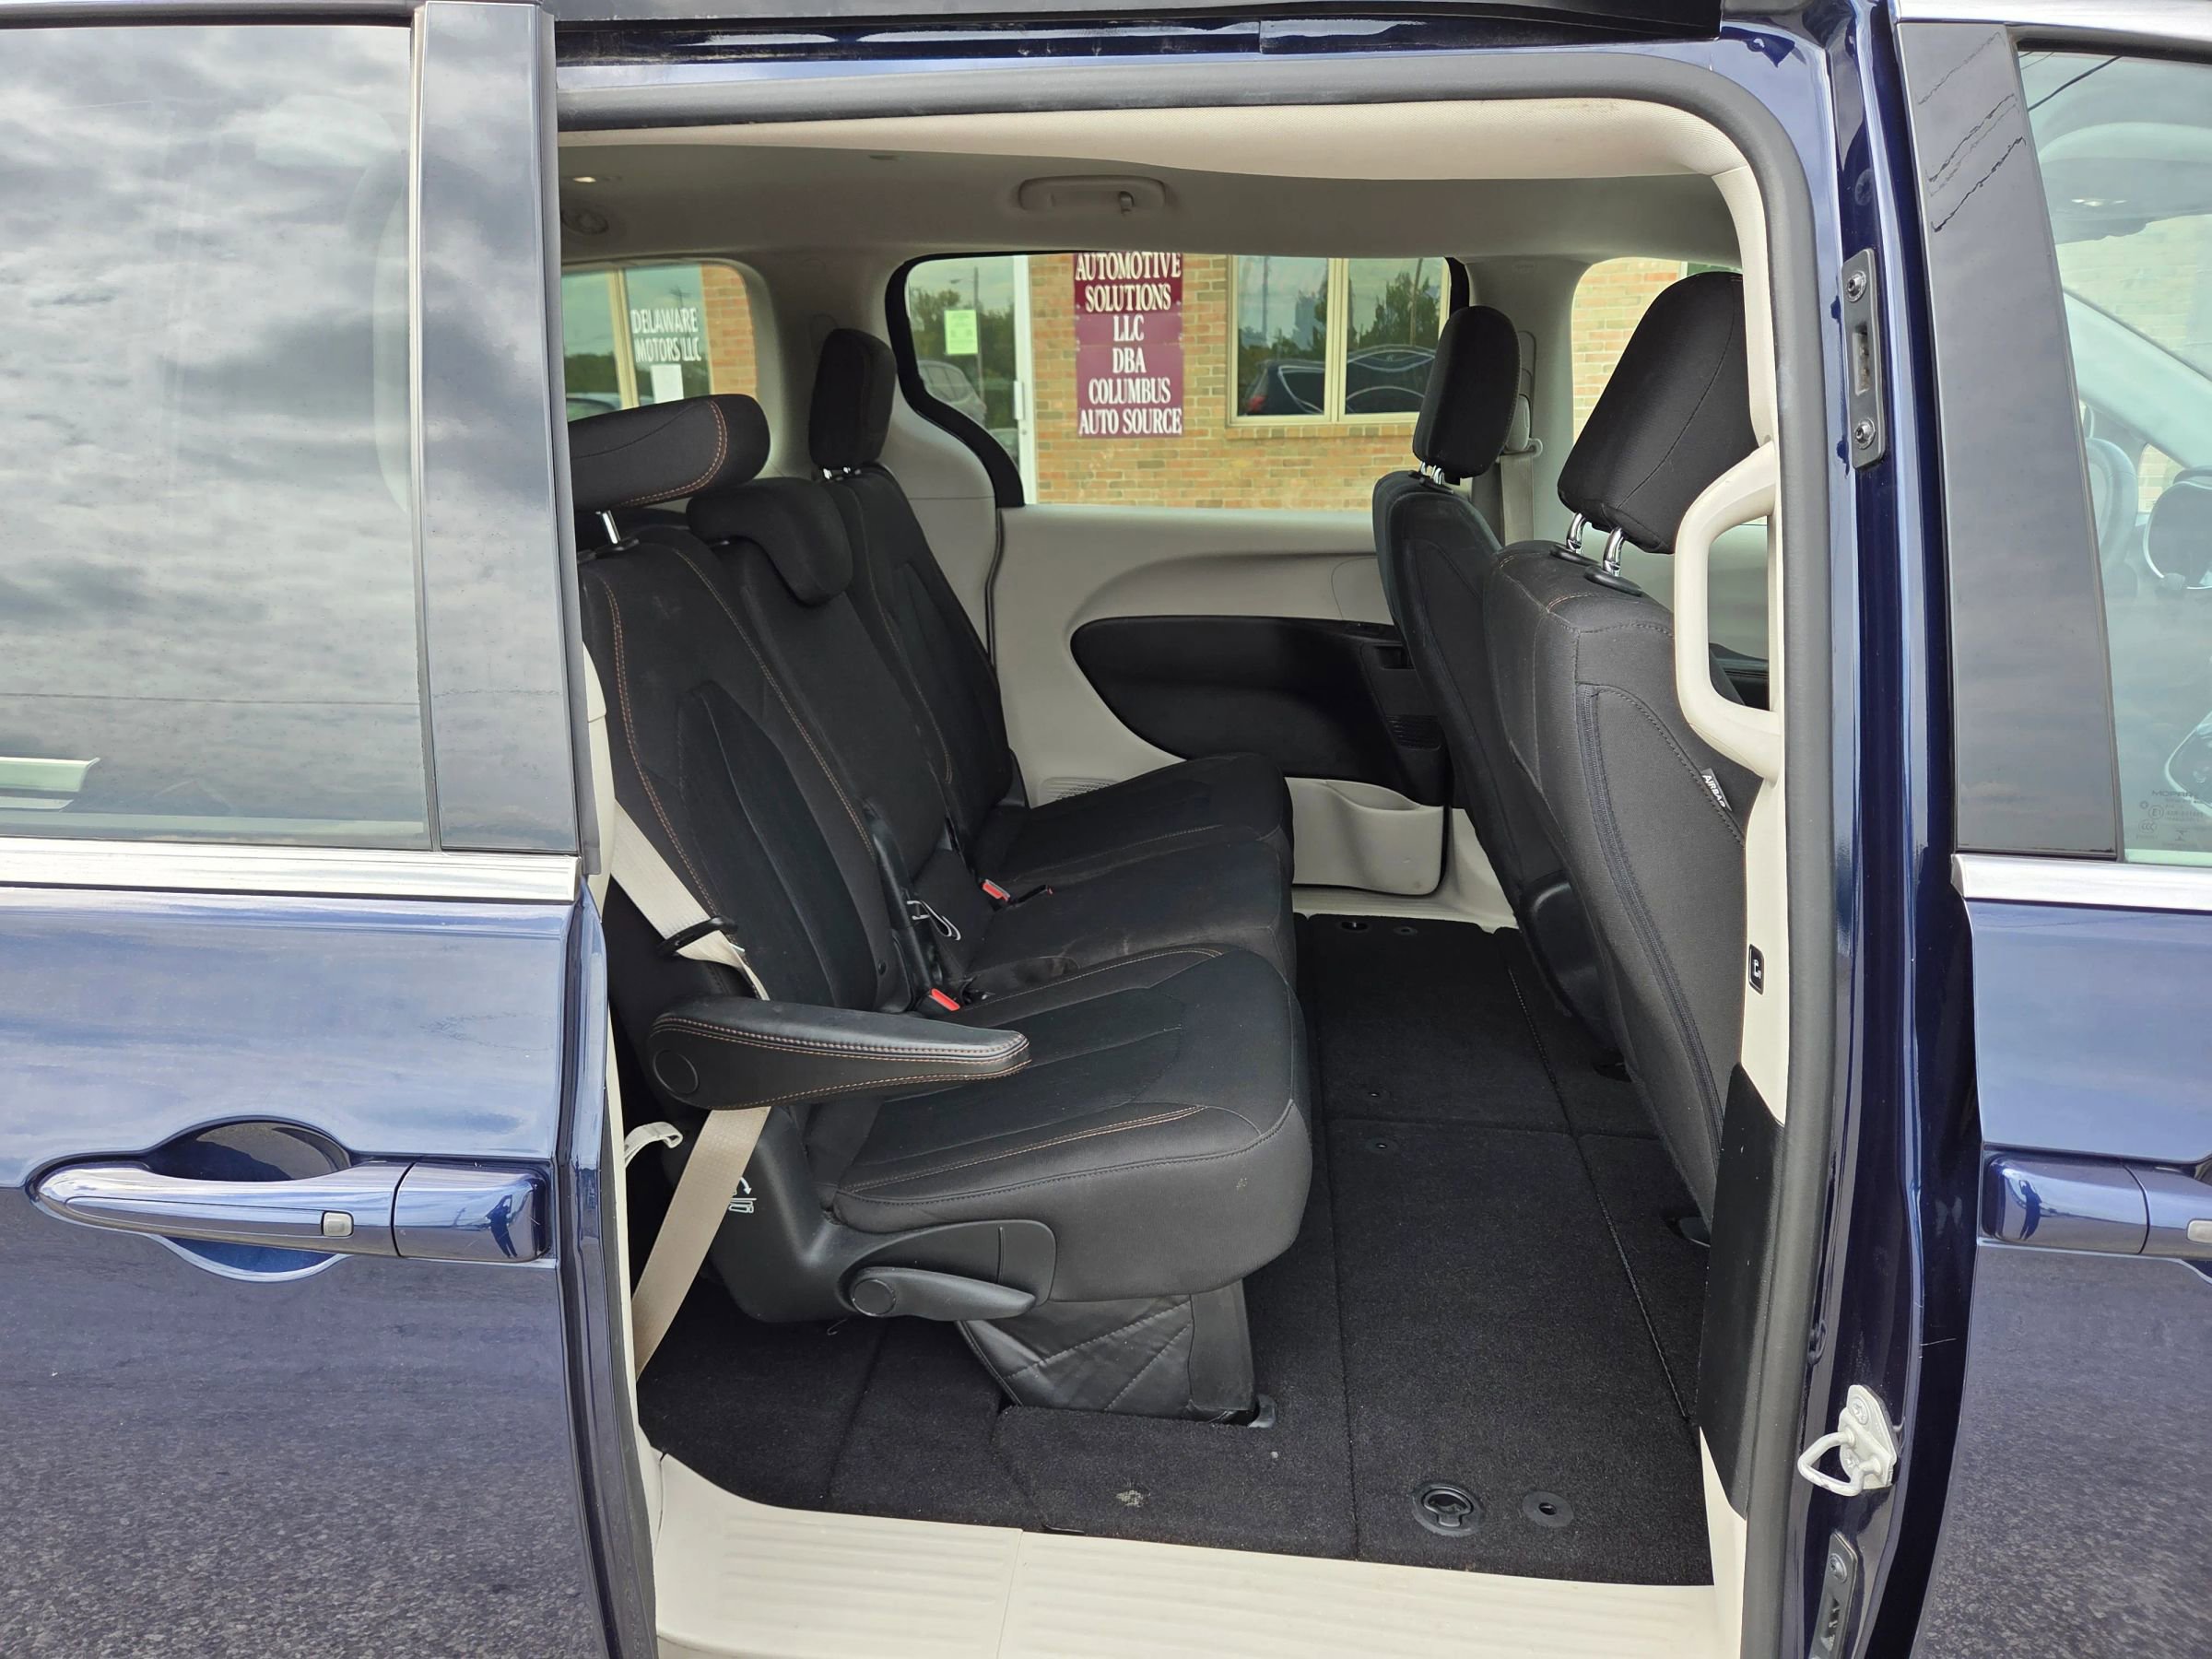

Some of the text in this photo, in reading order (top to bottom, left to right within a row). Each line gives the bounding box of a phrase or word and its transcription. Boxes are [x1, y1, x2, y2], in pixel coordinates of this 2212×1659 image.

[1075, 251, 1182, 281] AUTOMOTIVE
[1085, 283, 1171, 312] SOLUTIONS
[630, 307, 699, 334] DELAWARE
[1112, 313, 1145, 342] LLC
[634, 336, 701, 362] MOTORS LLC
[1112, 347, 1147, 374] DBA
[1088, 377, 1171, 405] COLUMBUS
[1078, 407, 1182, 436] AUTO SOURCE
